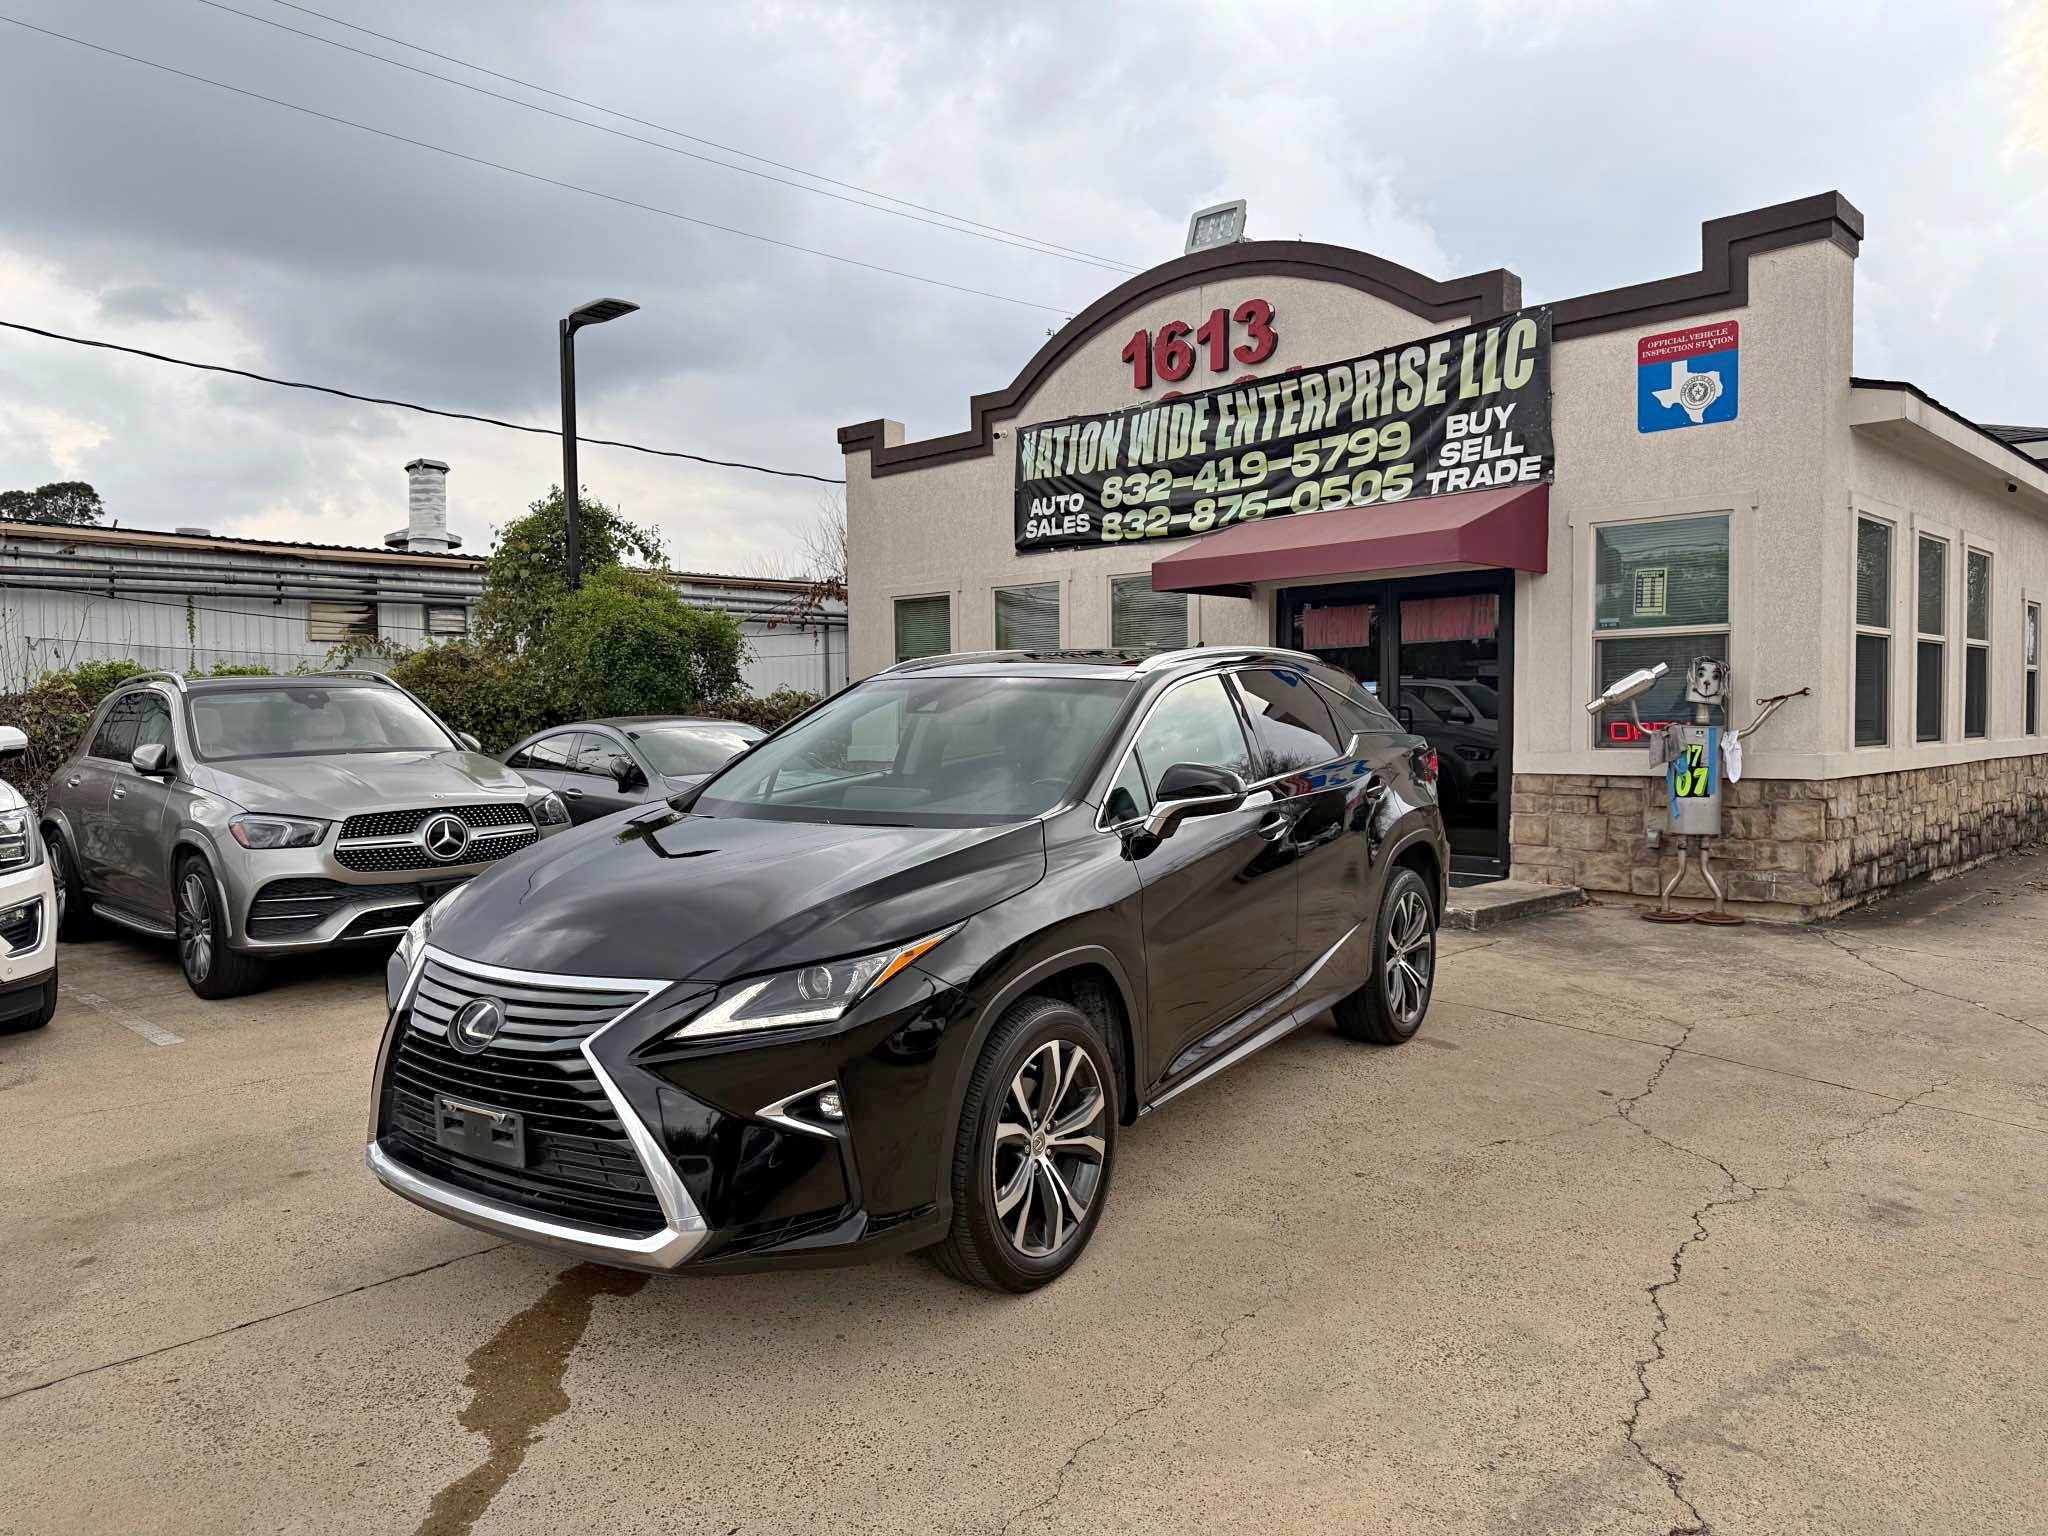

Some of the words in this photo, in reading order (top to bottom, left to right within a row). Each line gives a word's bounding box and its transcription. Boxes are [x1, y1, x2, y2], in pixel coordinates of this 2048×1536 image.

[1122, 299, 1277, 389] 1613
[1642, 343, 1695, 359] INSPECTION
[1695, 335, 1734, 349] STATION
[1647, 335, 1688, 349] OFFICIAL
[1689, 327, 1729, 341] VEHICLE
[1022, 417, 1125, 482] NATION
[1128, 398, 1209, 468] WIDE
[1215, 339, 1451, 451] ENTERPRISE
[1459, 318, 1537, 400] LLC
[1446, 403, 1517, 440] BUY
[1100, 421, 1412, 509] 832-419-5799
[1438, 431, 1525, 467] SELL
[1425, 455, 1543, 495] TRADE
[1030, 493, 1085, 518] AUTO
[1100, 463, 1415, 542] 832-876-0505
[1025, 513, 1091, 539] SALES
